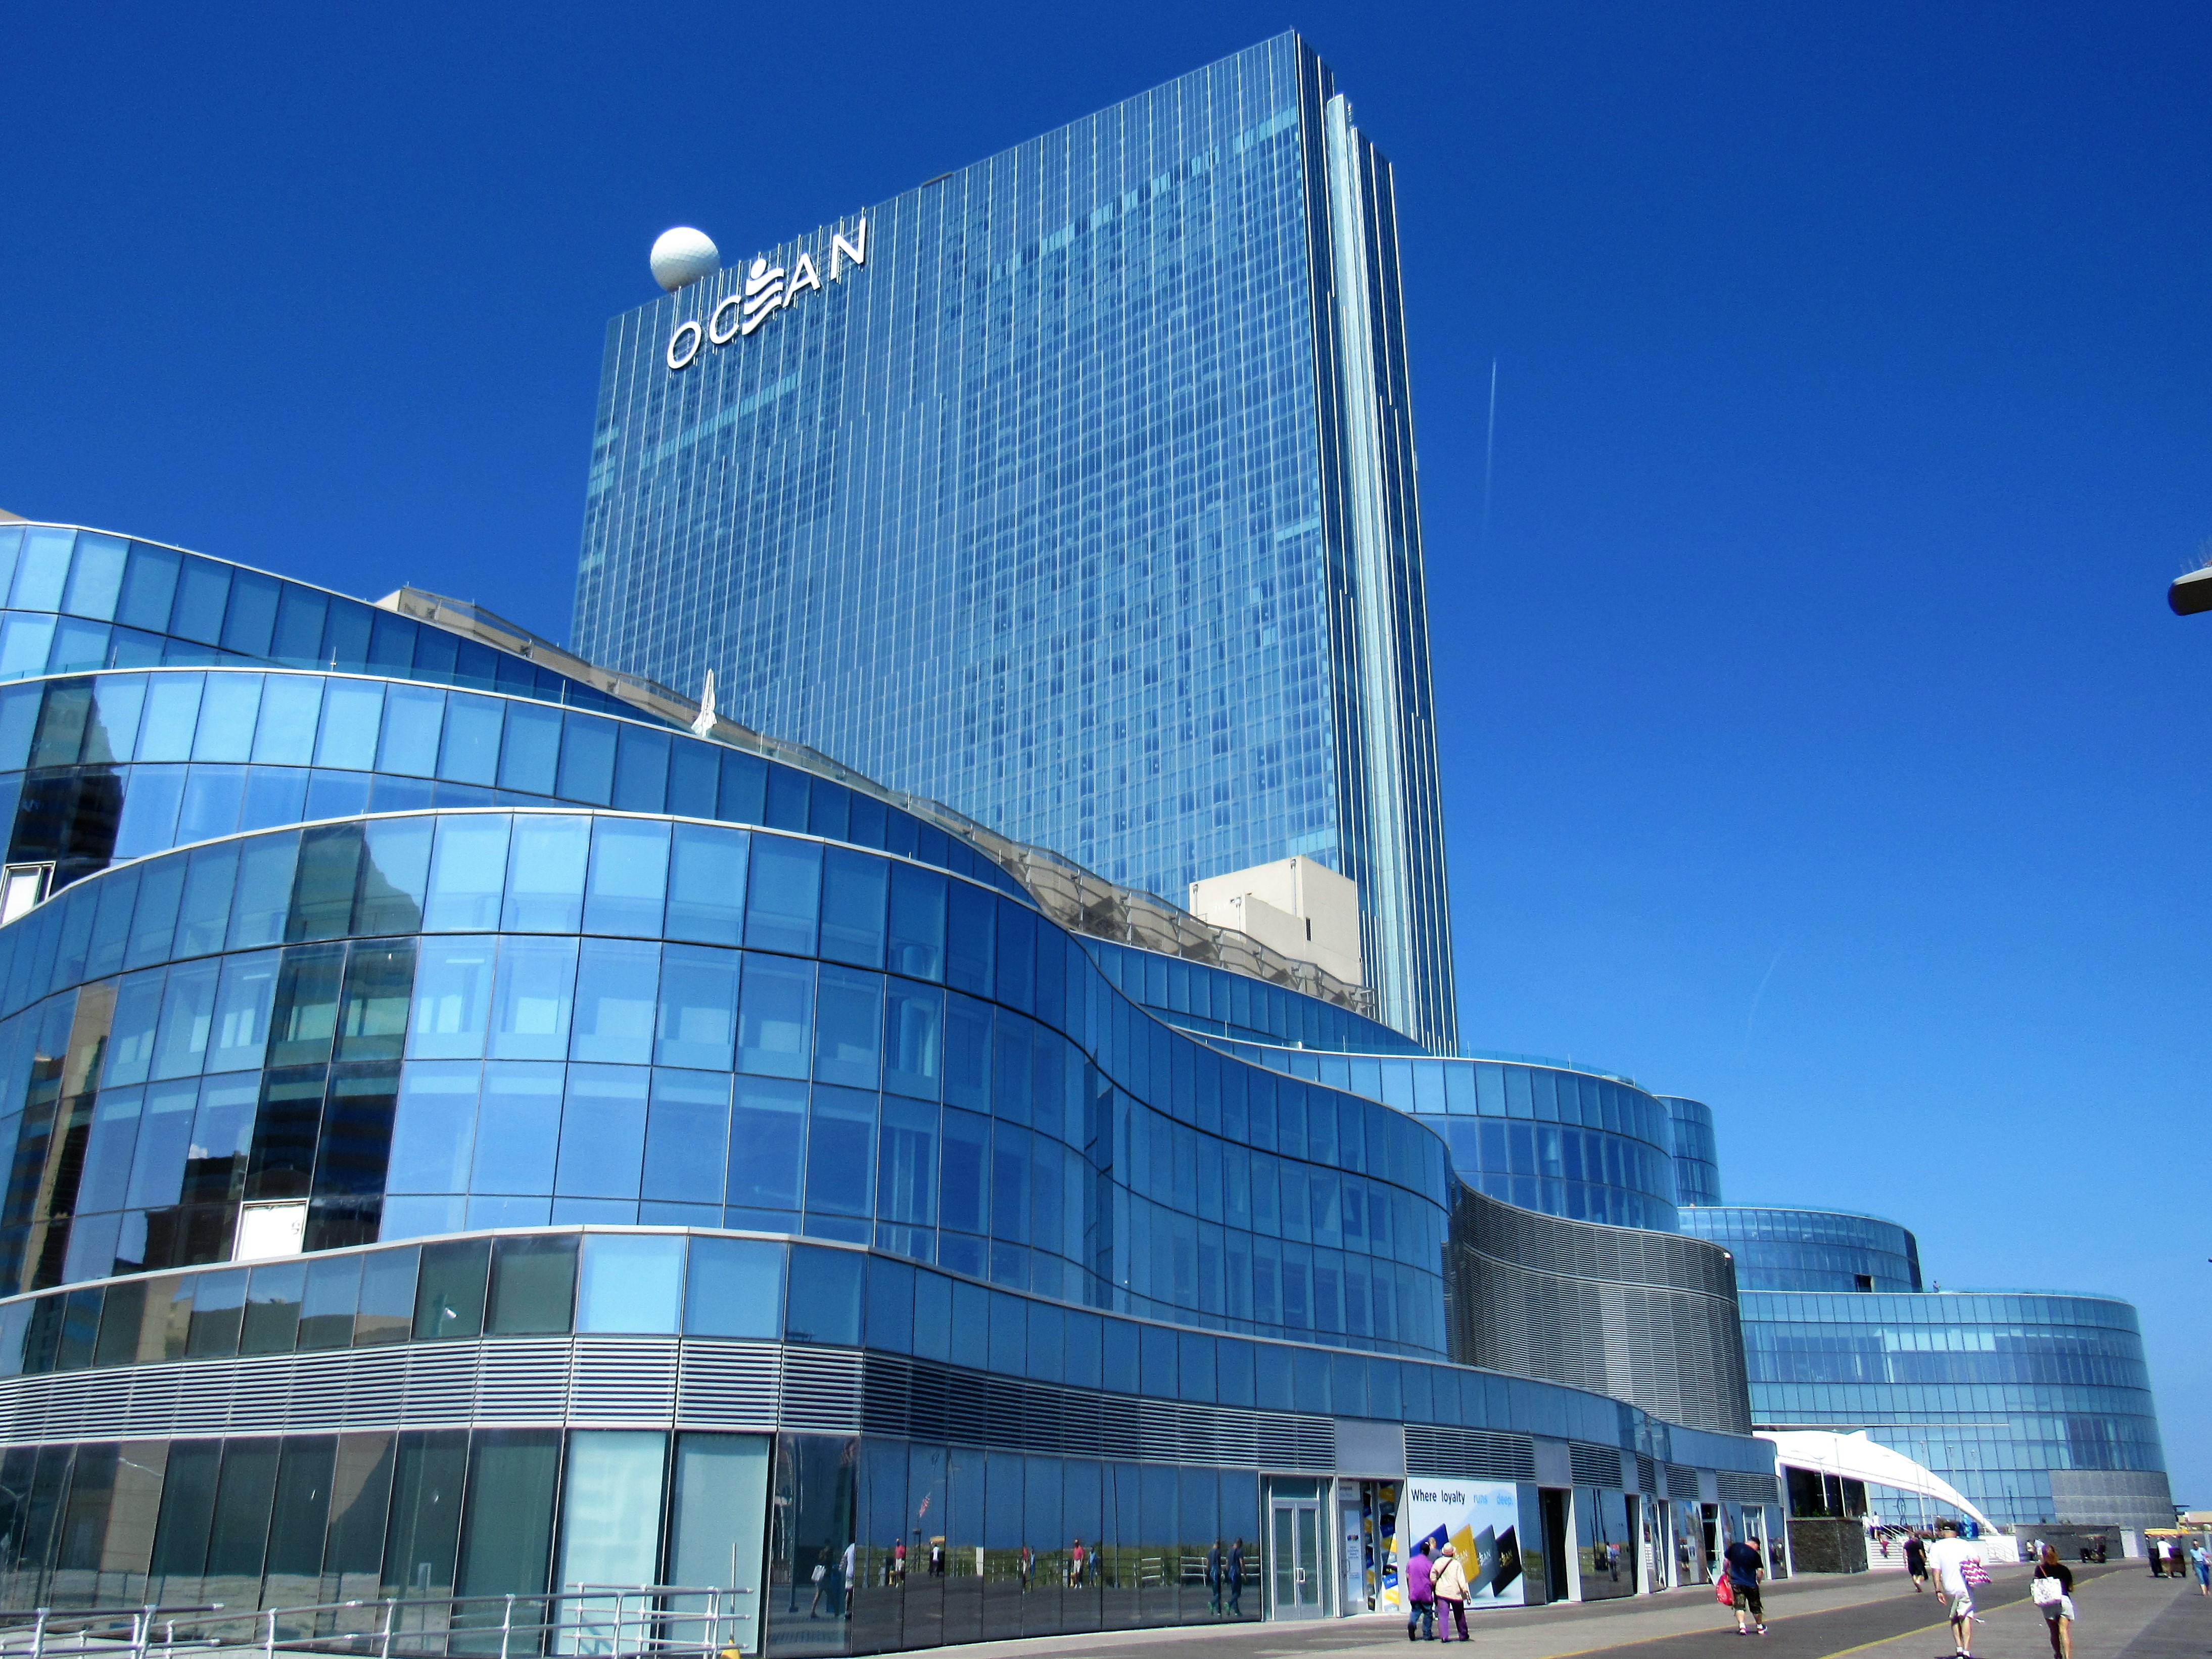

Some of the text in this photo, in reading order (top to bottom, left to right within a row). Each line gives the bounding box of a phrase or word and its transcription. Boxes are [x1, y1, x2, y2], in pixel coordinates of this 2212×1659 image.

[667, 217, 867, 369] OCEAN
[1411, 1489, 1514, 1506] Where loyalty runs deep.
